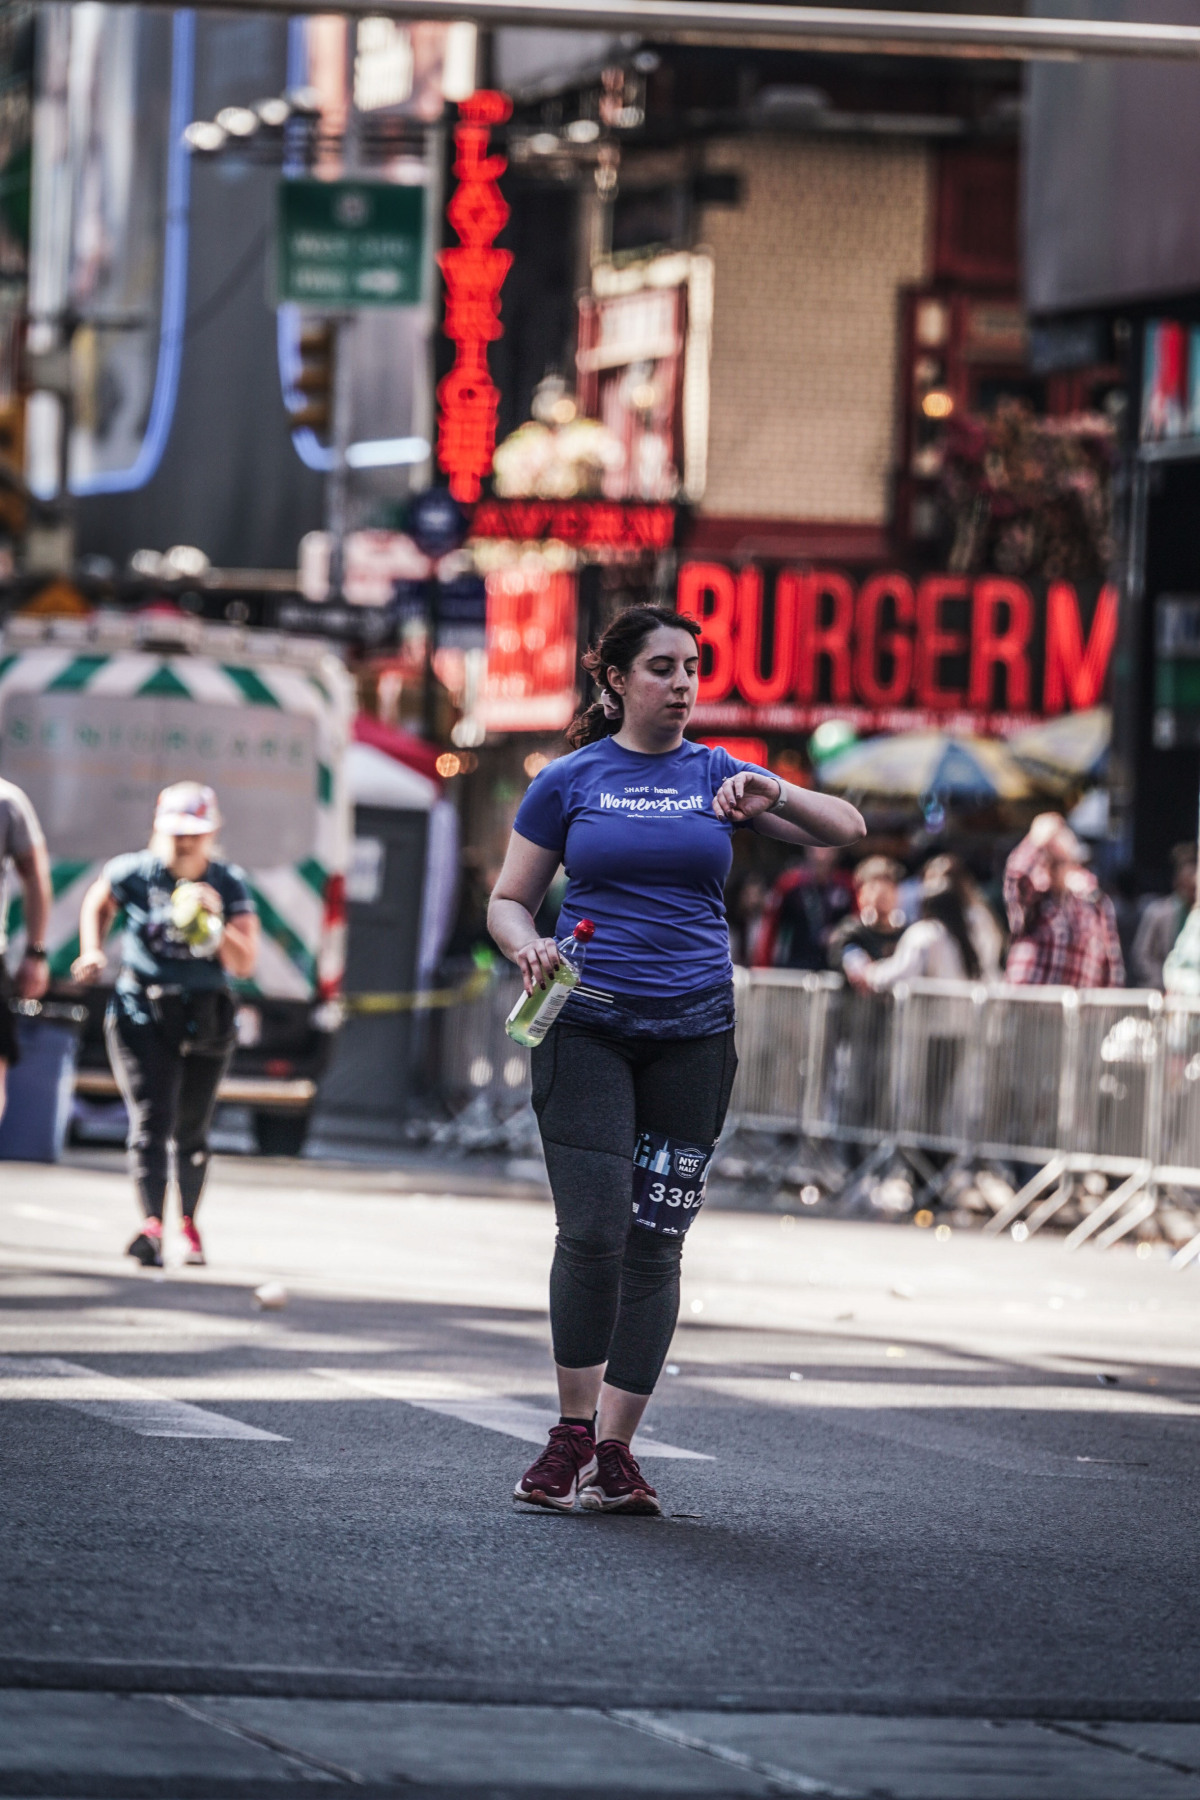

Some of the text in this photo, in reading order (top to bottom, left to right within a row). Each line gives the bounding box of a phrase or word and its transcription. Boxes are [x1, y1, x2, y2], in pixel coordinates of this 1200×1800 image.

[676, 561, 1034, 711] BURGER
[624, 786, 678, 795] SHAPE health
[679, 1156, 700, 1167] NYC
[678, 1165, 696, 1173] HALF
